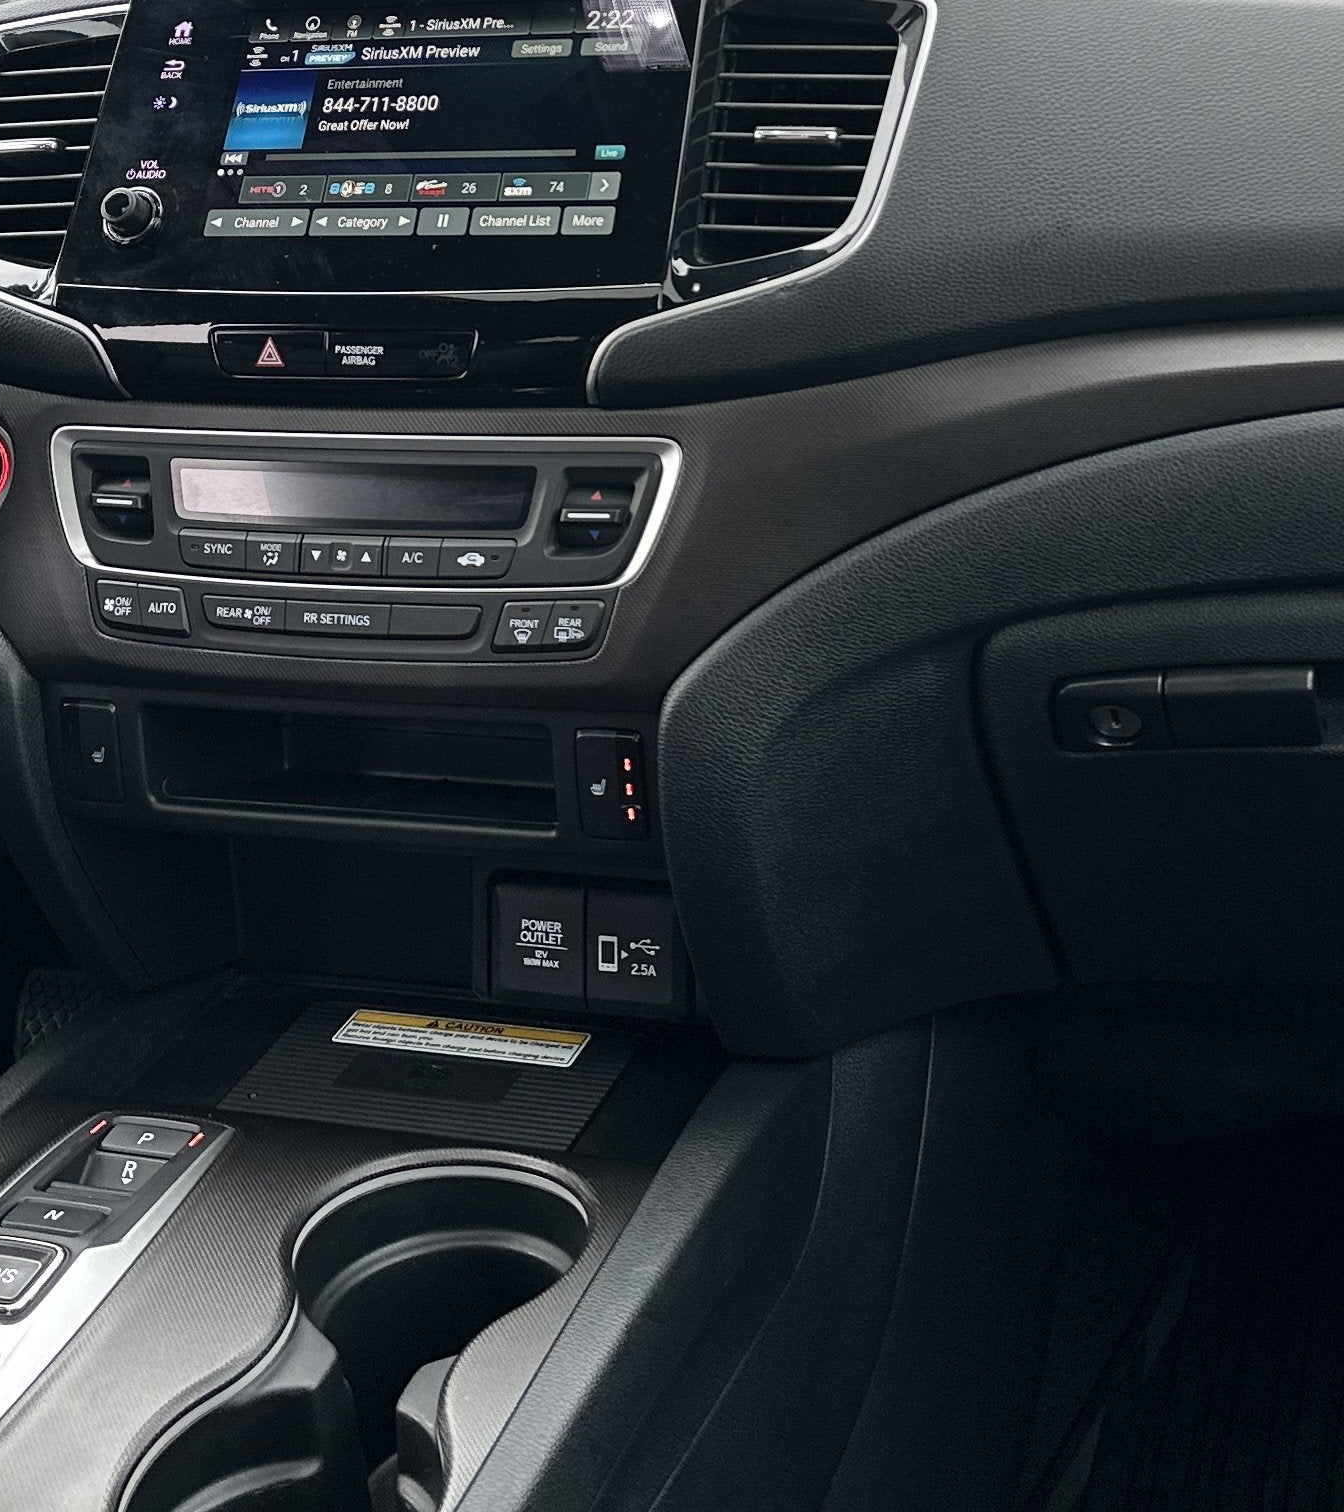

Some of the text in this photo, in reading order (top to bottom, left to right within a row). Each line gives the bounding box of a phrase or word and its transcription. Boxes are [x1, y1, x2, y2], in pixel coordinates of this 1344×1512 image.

[409, 19, 416, 31] 1
[426, 17, 481, 31] SiriusXM
[585, 9, 636, 31] 2:22
[168, 37, 193, 46] HOME
[594, 41, 628, 52] Sound
[360, 44, 481, 61] SiriusXM Preview
[520, 43, 563, 56] Settings
[160, 71, 183, 80] BACK
[327, 78, 404, 89] Entertainment
[322, 94, 440, 114] 844-711-8800
[318, 118, 409, 132] Great Offer Now!
[140, 159, 160, 169] VOL
[135, 169, 167, 180] AUDIO
[298, 184, 308, 196] 2
[384, 183, 393, 195] 8
[460, 182, 477, 194] 26
[548, 181, 565, 193] 74
[233, 216, 280, 228] Channel
[337, 215, 388, 230] Category
[479, 214, 551, 227] Channel List
[571, 214, 605, 227] More
[334, 344, 384, 355] PASSENGER
[341, 355, 376, 366] AIRBAG
[203, 543, 233, 555] SYNC
[260, 543, 283, 552] MODE
[401, 551, 424, 564] A/C
[113, 606, 133, 616] OFF
[147, 602, 177, 614] AUTO
[216, 606, 243, 618] REAR
[252, 616, 272, 626] OFF
[303, 612, 372, 627] RR SETTINGS
[508, 618, 540, 629] FRONT
[557, 617, 582, 628] REAR
[521, 918, 562, 934] POWER
[519, 931, 564, 946] OUTLET
[534, 949, 549, 959] 12V
[541, 958, 560, 969] MAX
[630, 962, 657, 977] 2.5A
[445, 1020, 504, 1034] CAUTION
[136, 1131, 156, 1146] P
[121, 1160, 138, 1180] R
[42, 1209, 67, 1222] N
